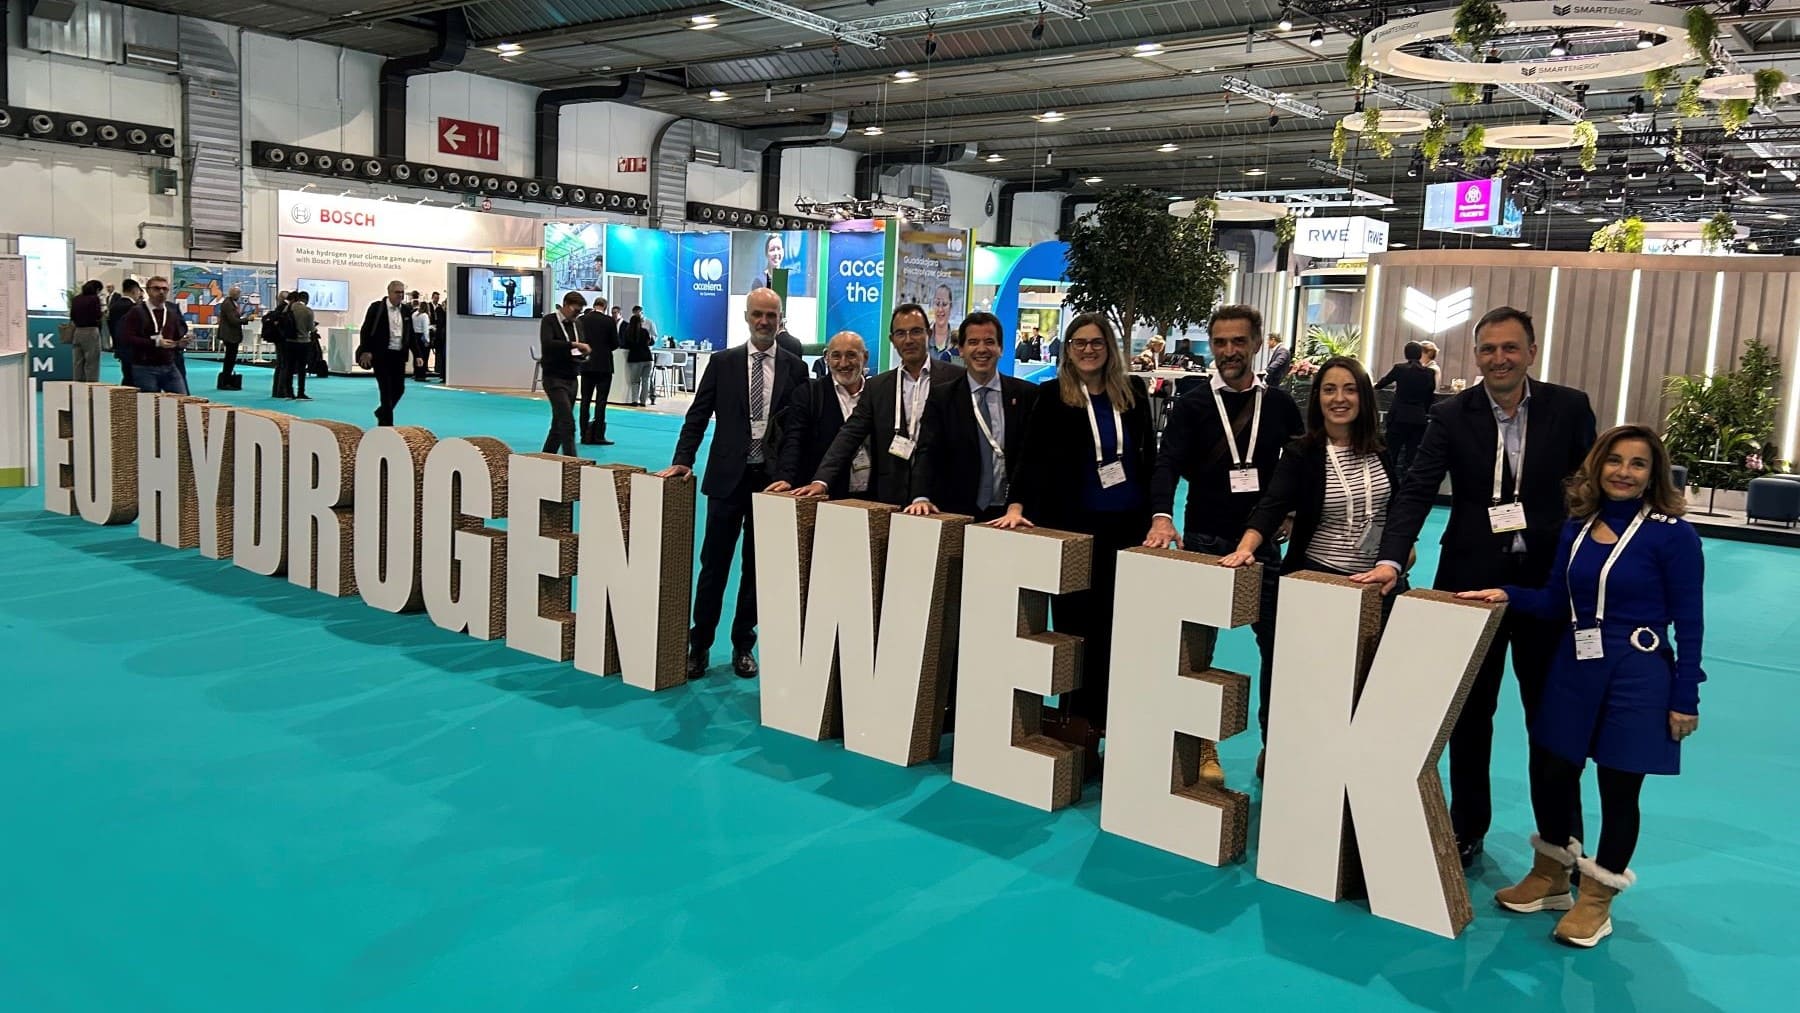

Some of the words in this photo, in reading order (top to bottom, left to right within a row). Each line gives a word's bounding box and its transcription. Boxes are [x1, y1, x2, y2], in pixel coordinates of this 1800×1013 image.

[1573, 6, 1644, 16] SMARTENERGY
[1538, 63, 1600, 74] SMARTENERGY
[320, 208, 375, 227] BOSCH
[1308, 229, 1349, 242] RWE
[1367, 230, 1384, 246] RWE
[296, 247, 315, 255] Make
[316, 249, 348, 259] hydrogen
[348, 252, 364, 260] your
[364, 252, 388, 261] climate
[389, 255, 407, 263] game
[407, 257, 432, 265] changer
[296, 255, 311, 264] with
[311, 257, 332, 265] Bosch
[348, 259, 382, 269] electrolysis
[383, 262, 402, 270] stacks
[903, 255, 939, 269] Guadalajara
[846, 281, 880, 303] the
[43, 381, 125, 526] EU
[138, 391, 680, 690] HYDROGEN
[751, 492, 1500, 938] WEEK
